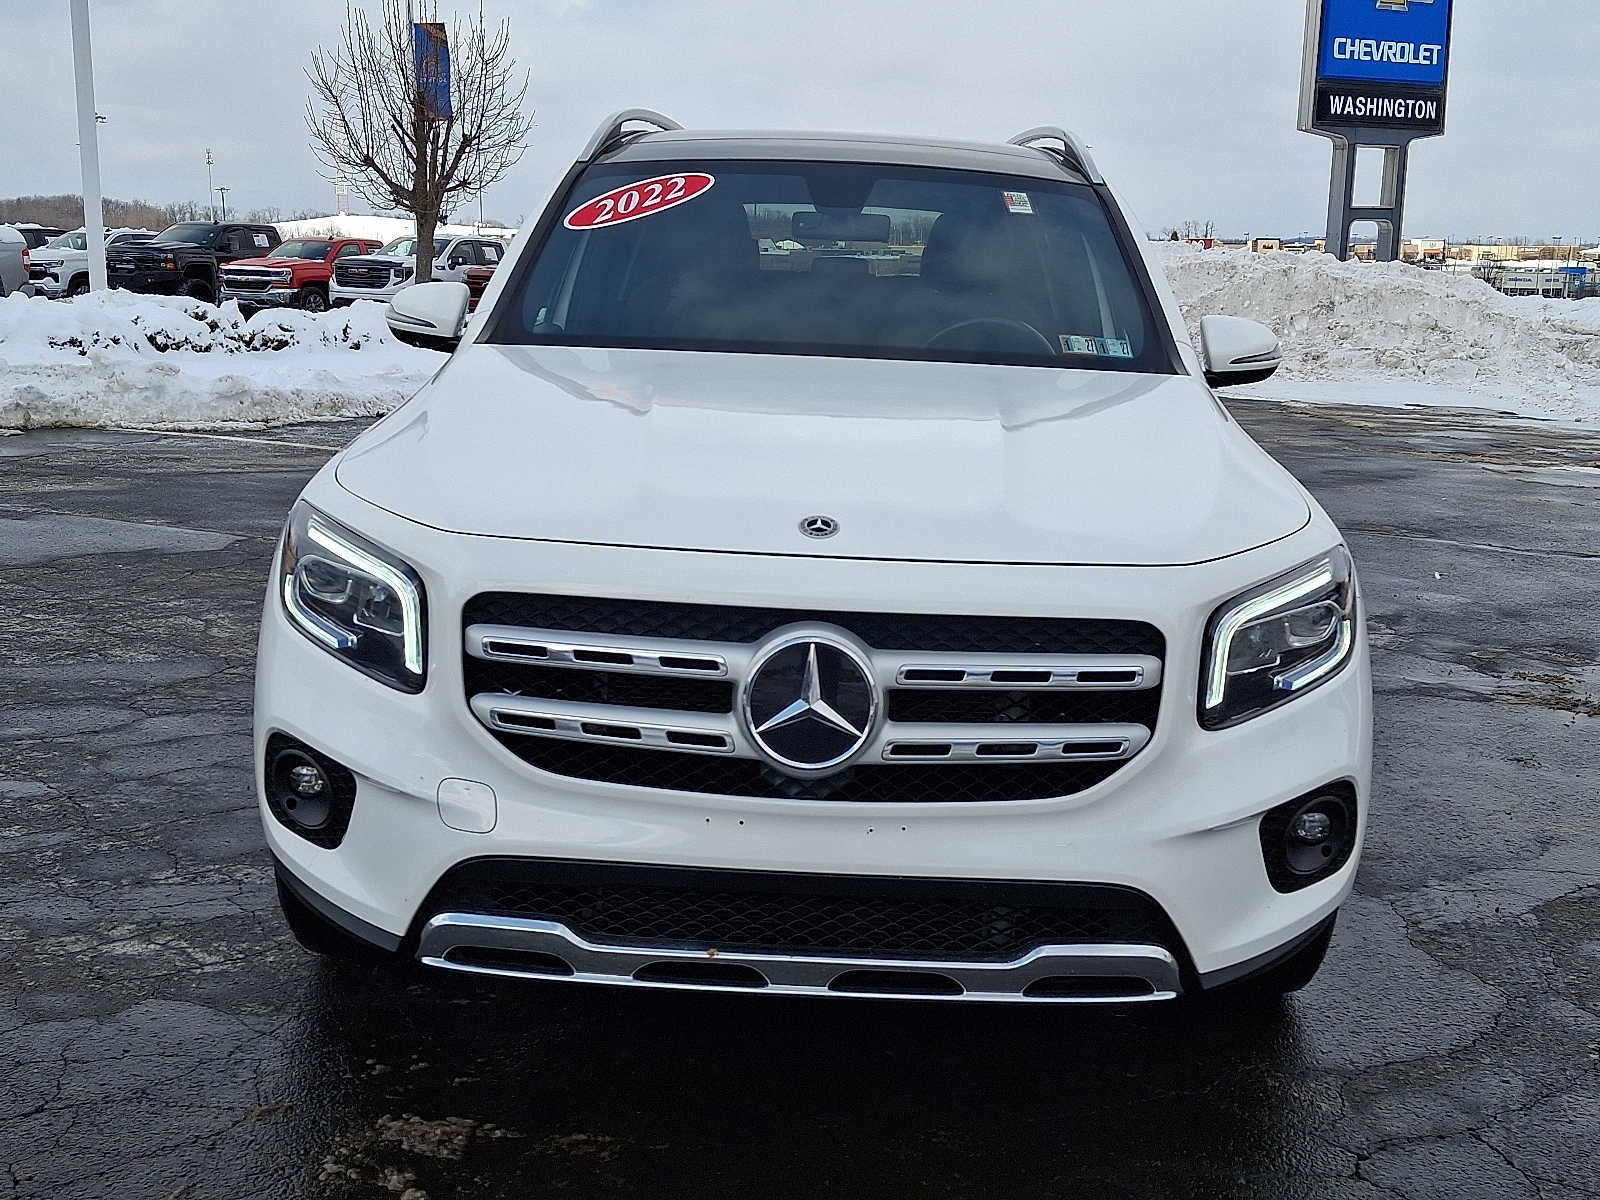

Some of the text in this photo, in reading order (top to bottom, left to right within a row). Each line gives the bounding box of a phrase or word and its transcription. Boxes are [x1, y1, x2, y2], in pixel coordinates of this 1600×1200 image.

[1333, 38, 1442, 65] CHEVROLET
[1330, 95, 1437, 119] WASHINGTON
[592, 177, 686, 224] 2022
